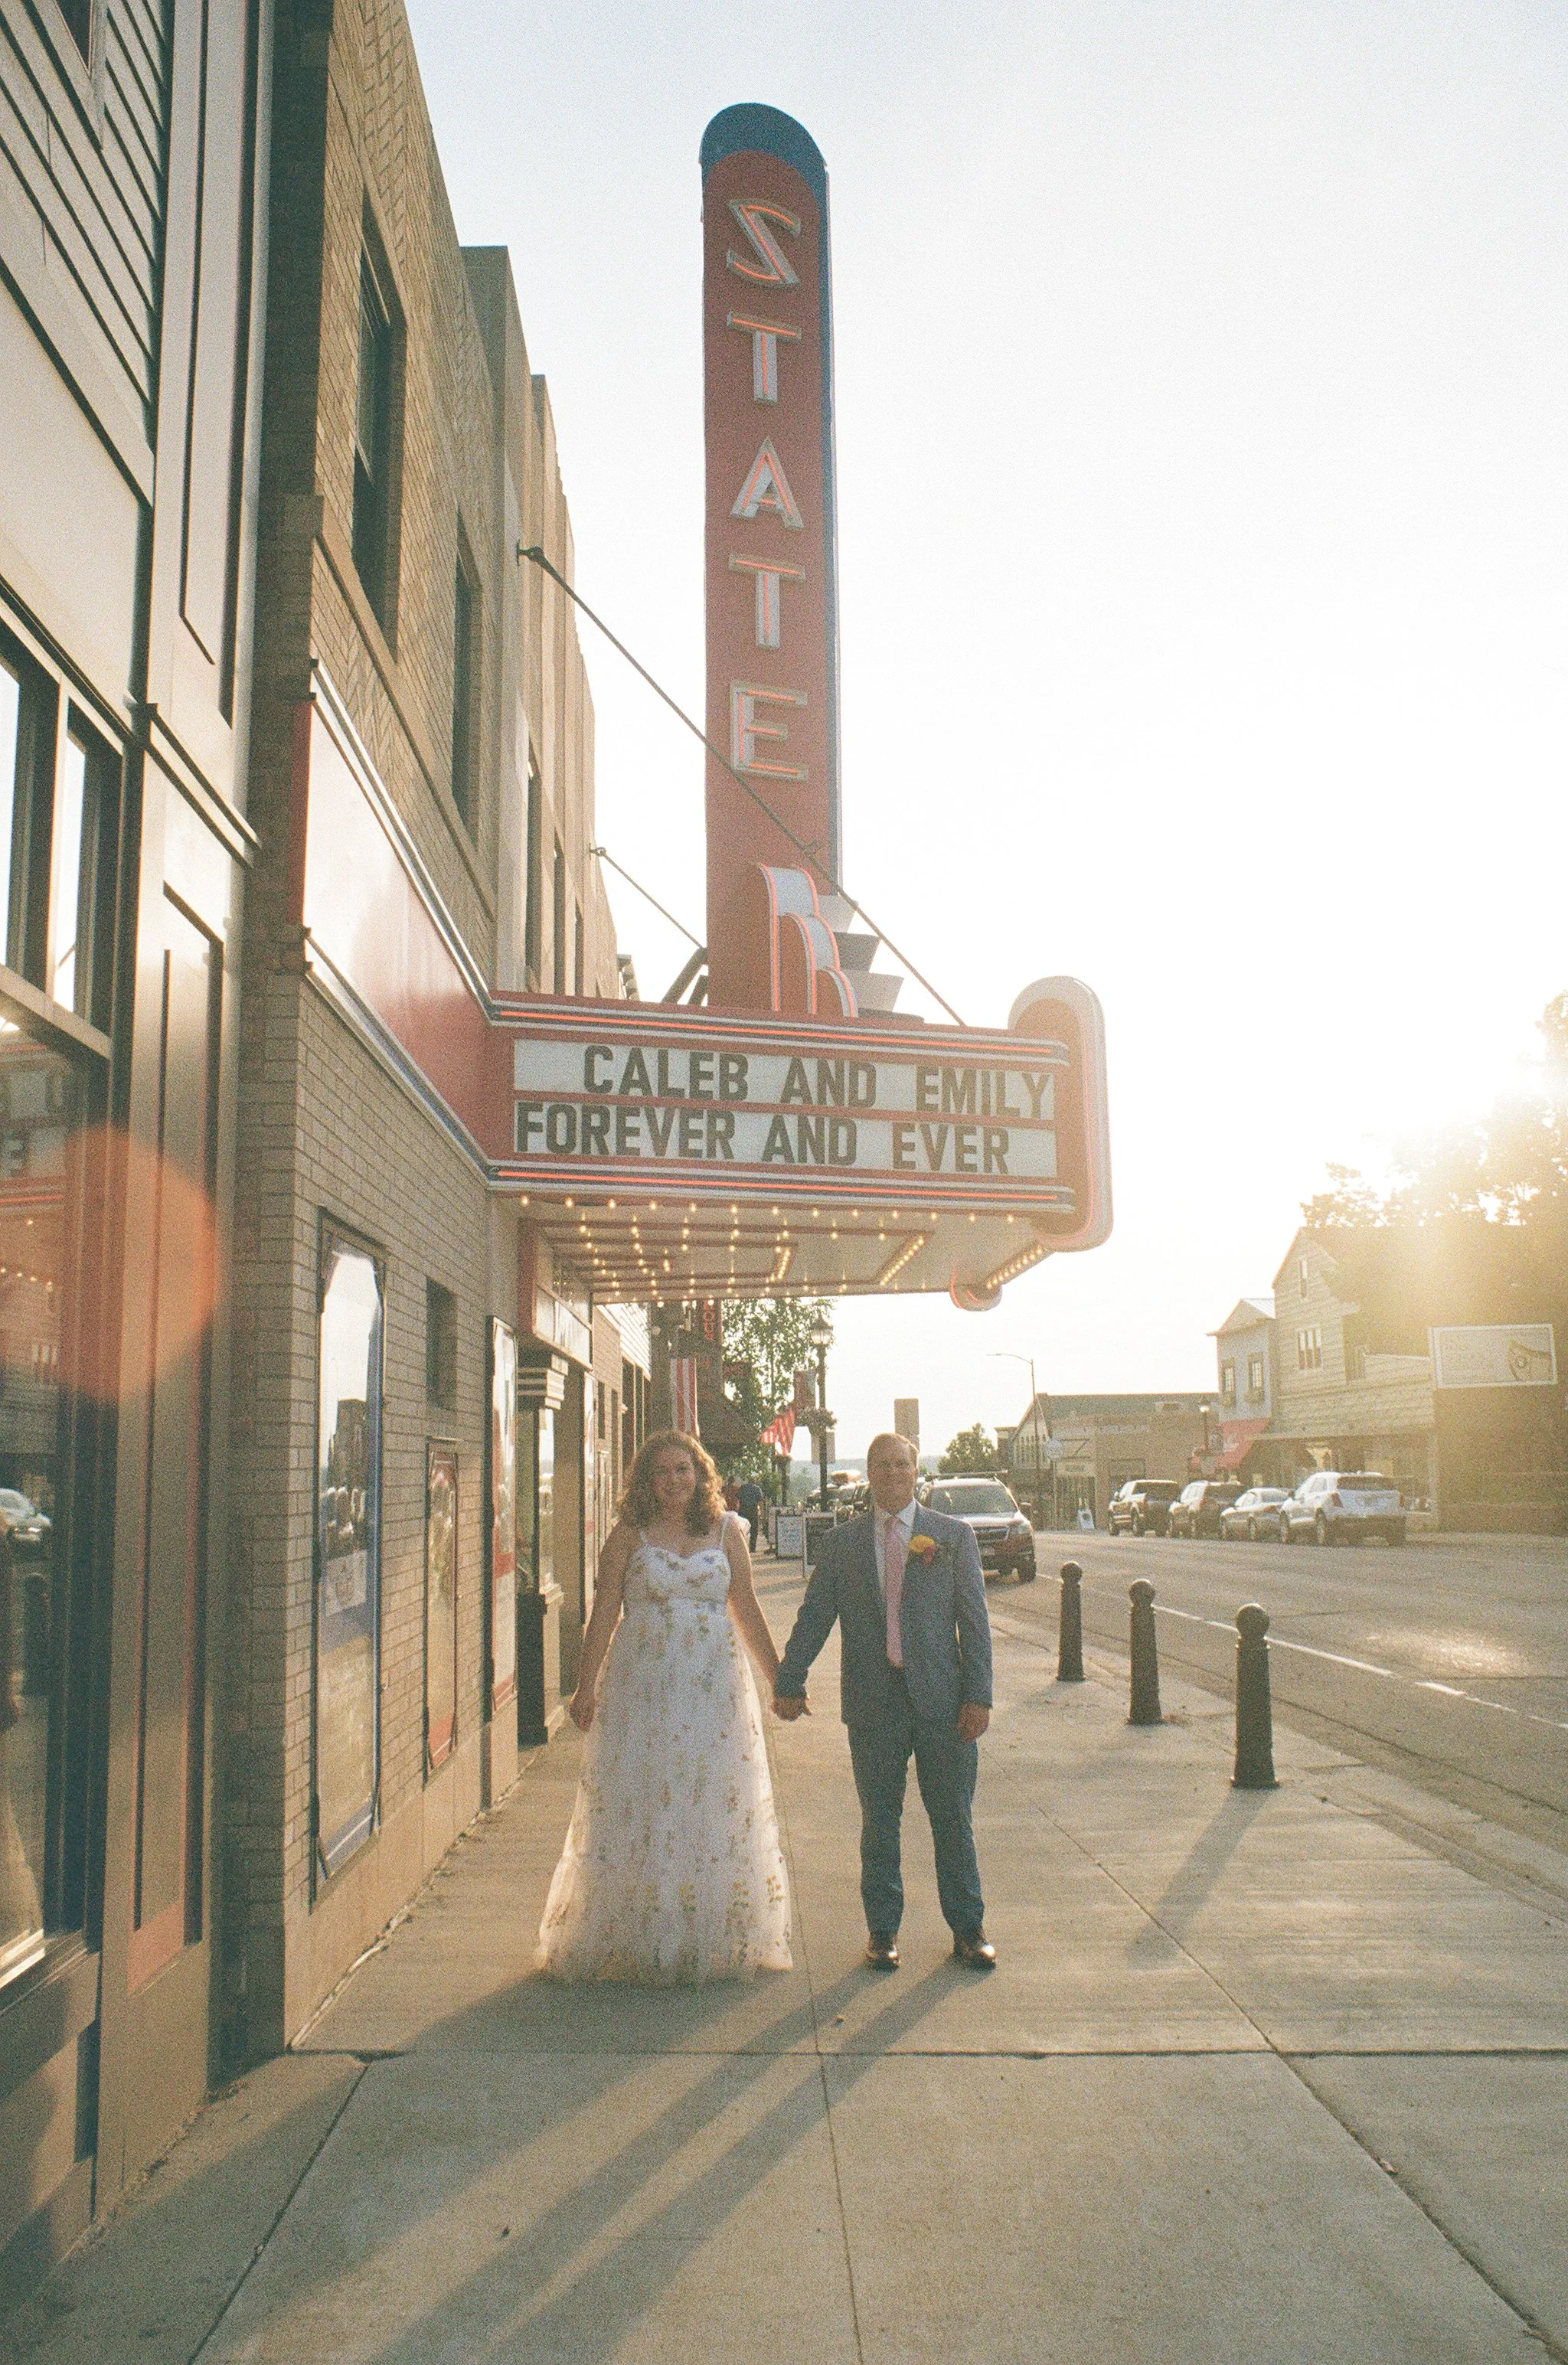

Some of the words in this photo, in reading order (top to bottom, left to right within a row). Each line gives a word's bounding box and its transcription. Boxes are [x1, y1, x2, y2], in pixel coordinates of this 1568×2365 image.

[726, 195, 808, 781] STATE
[583, 1044, 750, 1101] CALEB
[779, 1056, 877, 1109] AND
[916, 1064, 1050, 1119] EMILY
[516, 1101, 735, 1159] FOREVER
[762, 1113, 858, 1166] AND
[892, 1122, 1010, 1174] EVER
